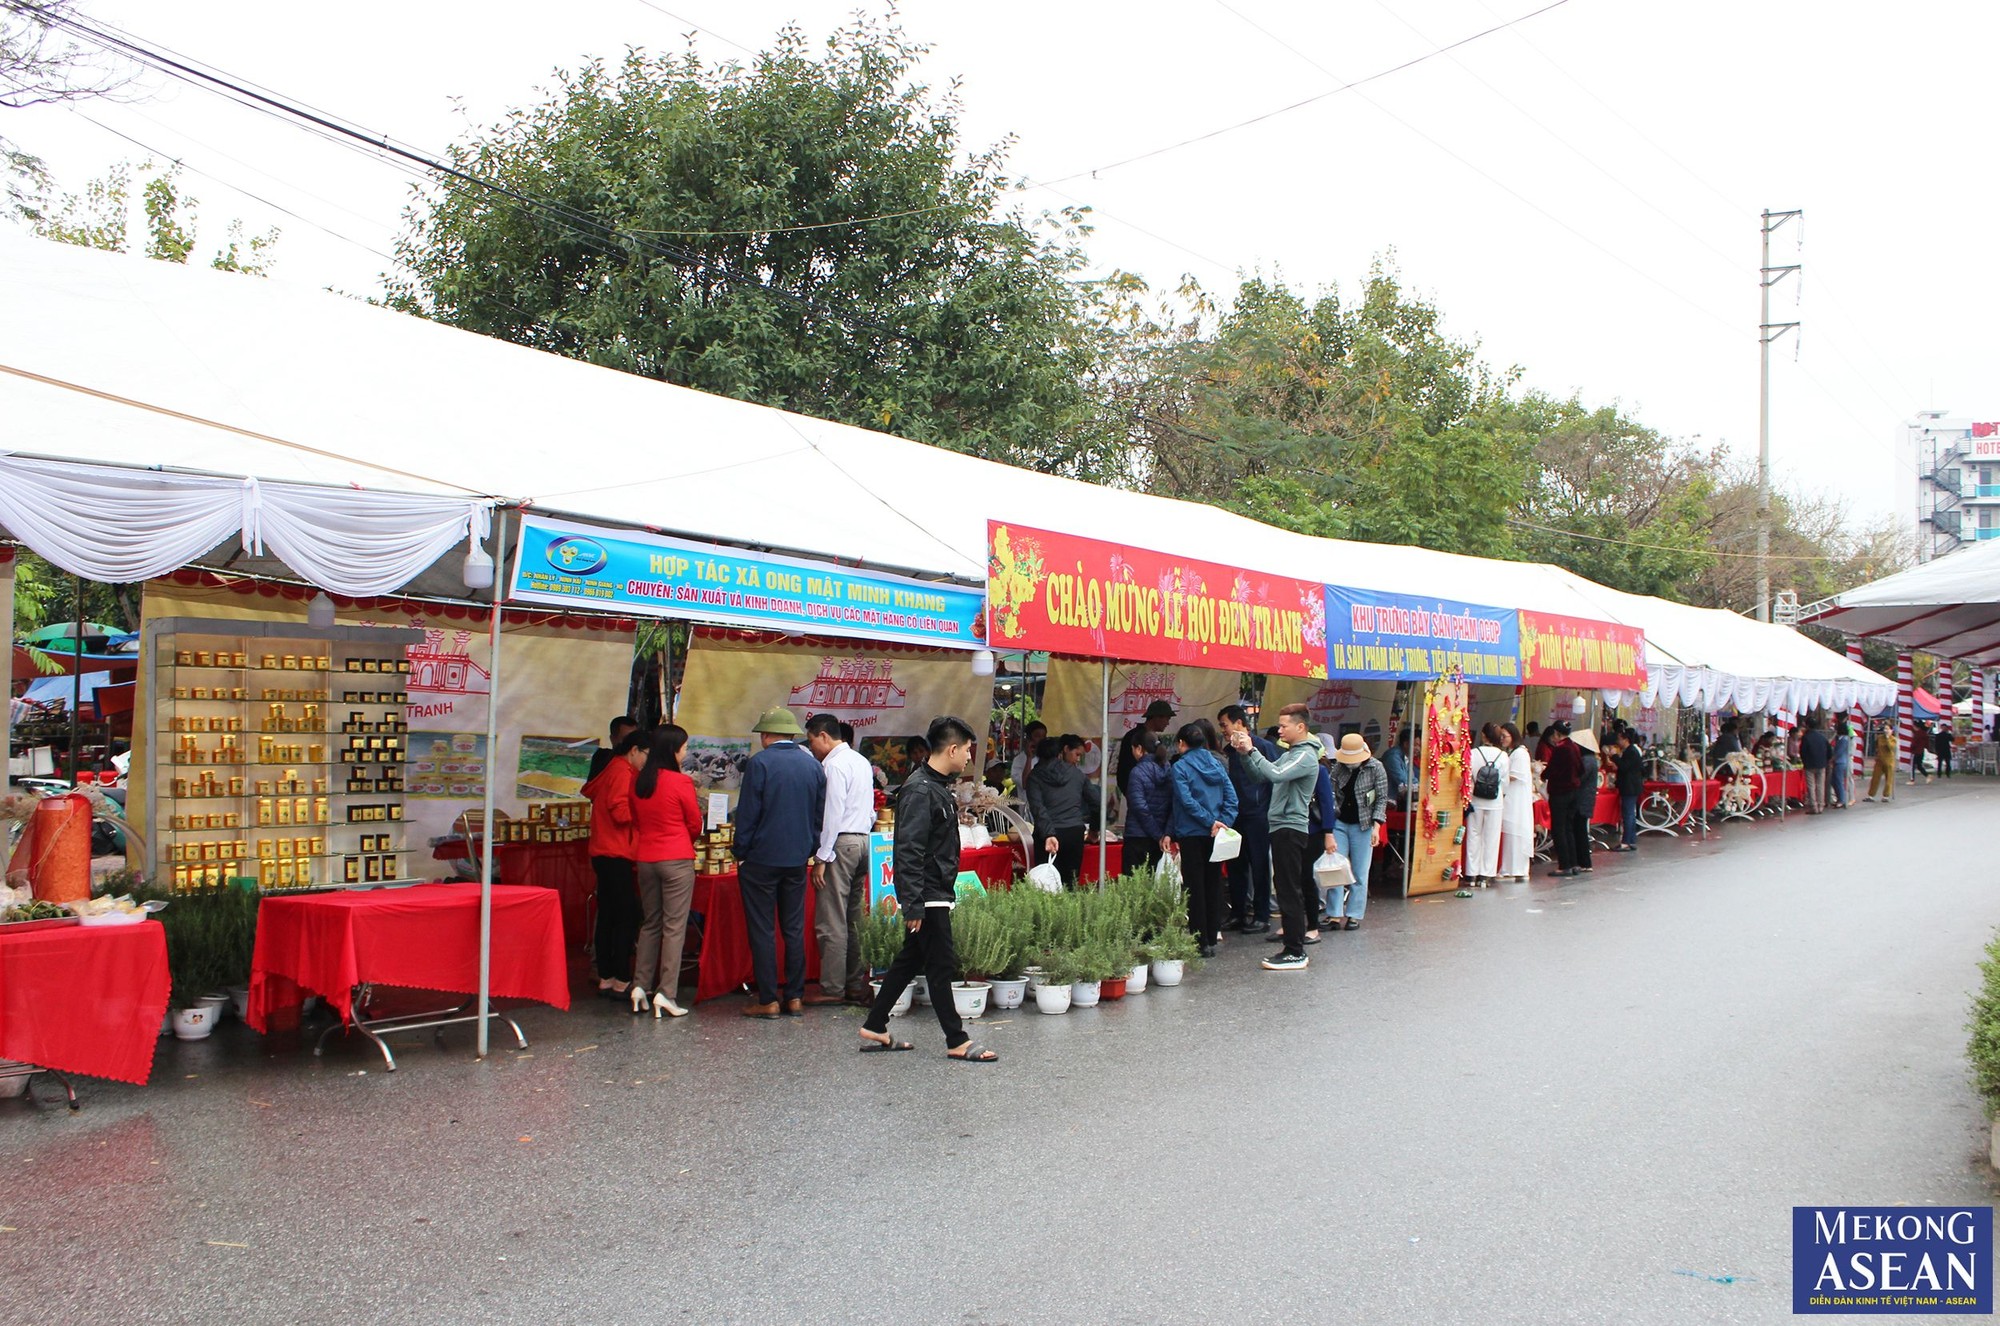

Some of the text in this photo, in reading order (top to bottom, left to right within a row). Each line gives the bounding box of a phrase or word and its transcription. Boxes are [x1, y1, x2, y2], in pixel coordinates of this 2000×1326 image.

[650, 554, 946, 612] HỢP TÁC XÃ ONG MẬT MINH KHANG
[627, 580, 674, 599] CHUYÊN:
[677, 585, 698, 602] SẢN
[701, 586, 727, 605] XUẤT
[730, 593, 742, 607] VÀ
[745, 596, 768, 610] KINH
[771, 599, 806, 615] DOANH,
[807, 604, 828, 620] DỊCH
[831, 607, 842, 622] VỤ
[844, 607, 861, 622] CÁC
[883, 611, 905, 627] HÀNG
[907, 614, 917, 628] CÓ
[920, 617, 937, 631] LIÊN
[938, 620, 959, 634] QUAN
[1046, 560, 1302, 655] CHÀO MỪNG LỄ HỘI ĐỀN TRANH
[1352, 603, 1500, 643] KHU TRƯNG BÀY SẢN PHẨM OCOP
[1334, 638, 1346, 670] VÀ
[1347, 634, 1363, 670] SẢN
[1365, 637, 1389, 672] PHẨM
[1389, 643, 1404, 677] ĐẶC
[1538, 625, 1562, 670] XUÂN
[1564, 627, 1582, 671] GIÁP
[1601, 632, 1619, 674] NĂM
[1619, 643, 1636, 676] 2024
[406, 701, 453, 718] TRANH
[848, 714, 877, 728] TRANH
